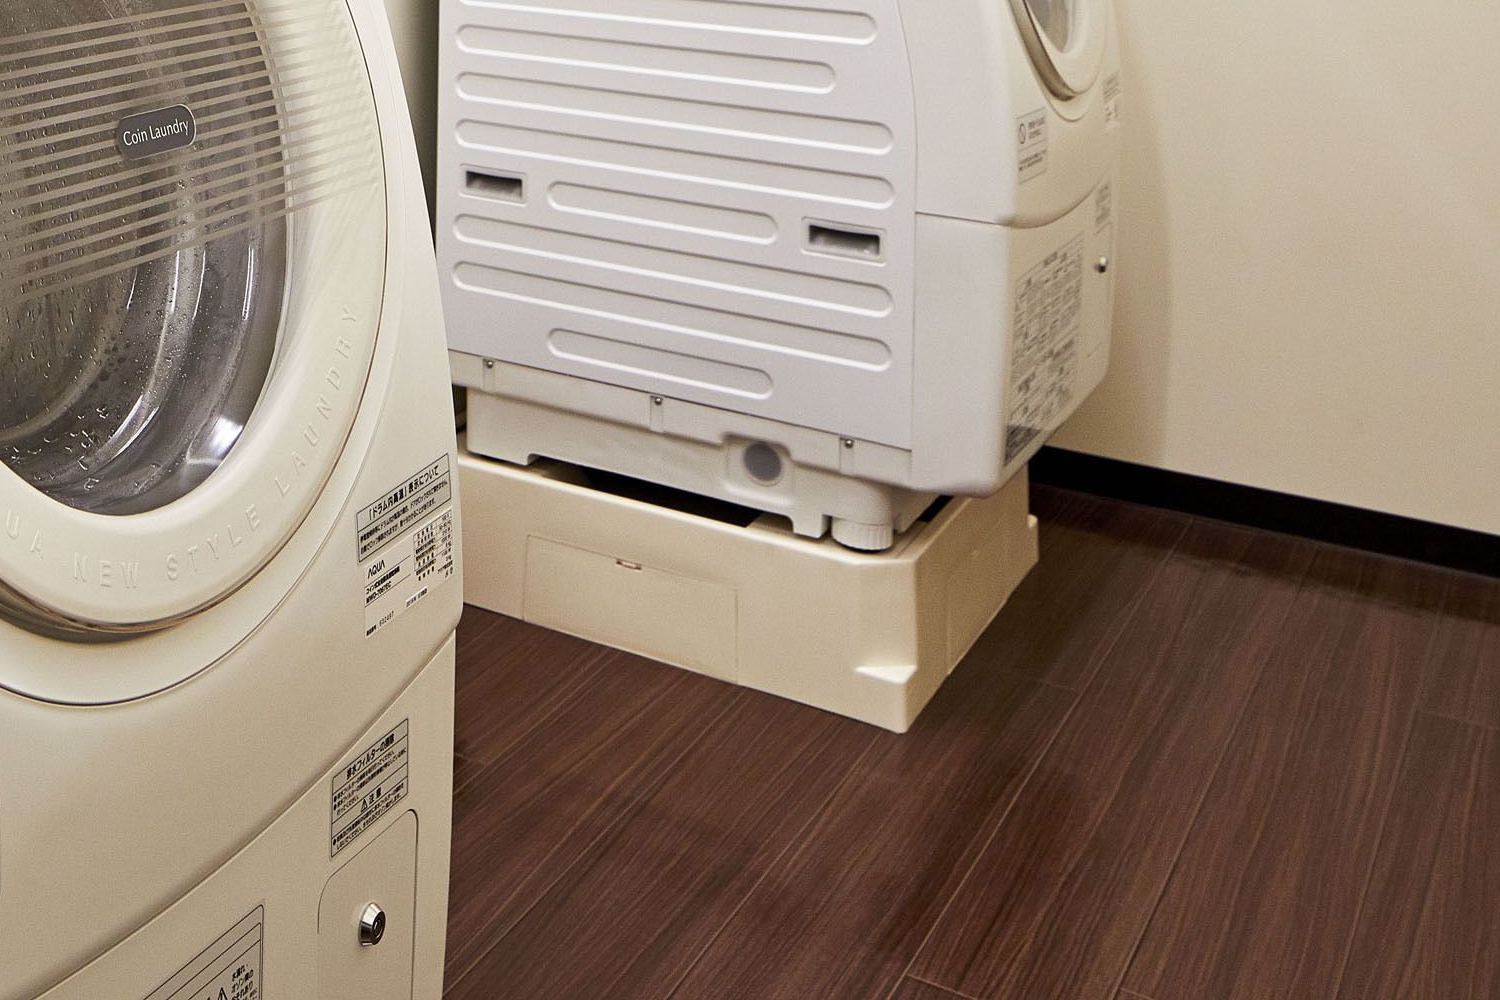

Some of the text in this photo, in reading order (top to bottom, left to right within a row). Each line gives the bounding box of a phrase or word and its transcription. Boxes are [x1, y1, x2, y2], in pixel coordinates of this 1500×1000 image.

[123, 118, 189, 146] Coin Laundry
[74, 551, 141, 589] NEW
[165, 503, 261, 581] STYLE
[274, 307, 357, 497] LAUNDRY
[367, 559, 386, 580] AQUA
